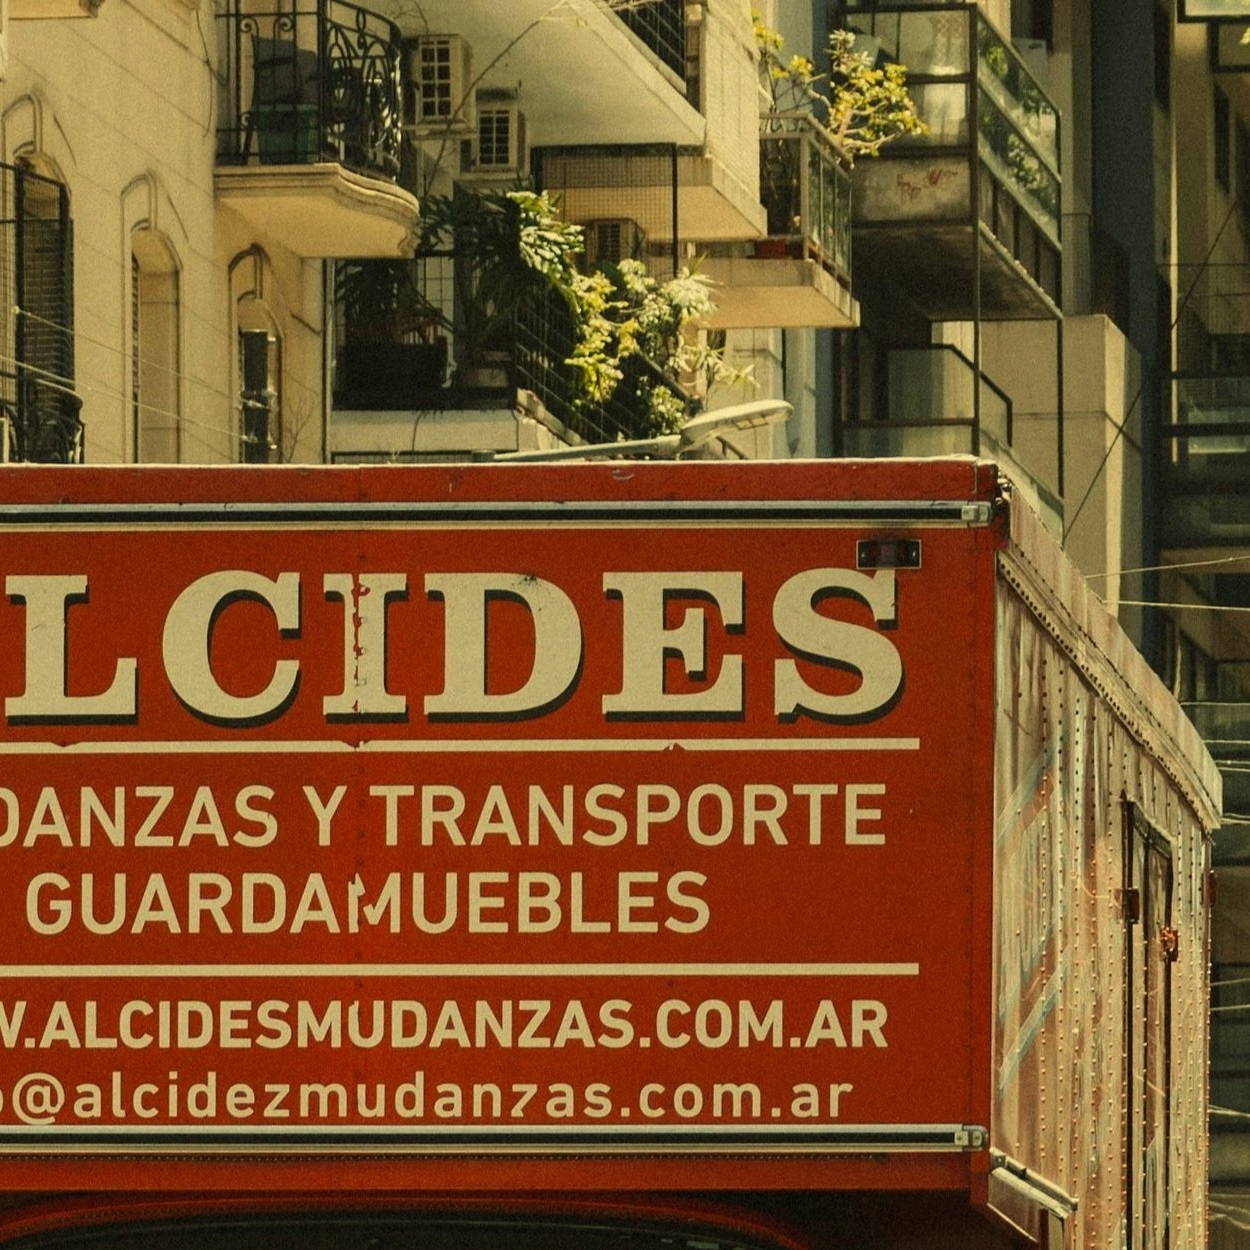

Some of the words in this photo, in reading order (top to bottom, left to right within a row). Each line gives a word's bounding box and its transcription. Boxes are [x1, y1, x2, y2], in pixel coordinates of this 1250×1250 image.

[301, 784, 348, 848] Y
[369, 783, 887, 848] TRANSPORTE
[26, 870, 711, 936] GUARDAMUEBLES
